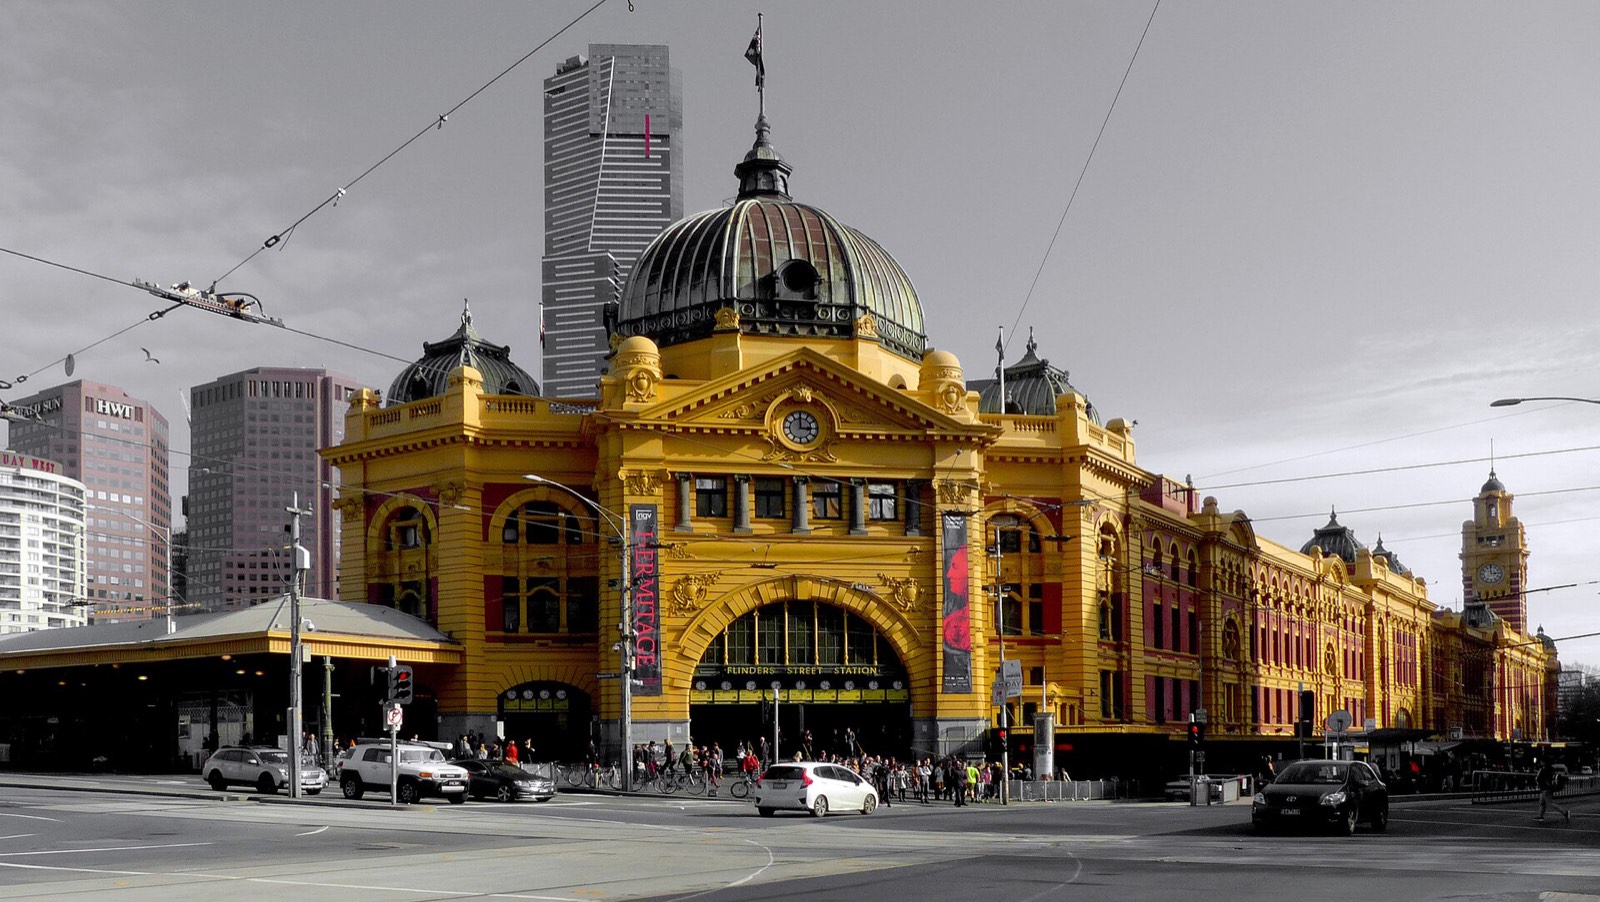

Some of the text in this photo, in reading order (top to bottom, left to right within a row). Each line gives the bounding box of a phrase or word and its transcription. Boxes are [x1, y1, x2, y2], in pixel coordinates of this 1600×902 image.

[43, 398, 61, 411] SUN
[97, 400, 133, 418] HWT
[3, 454, 54, 473] UAY WEST
[635, 531, 656, 666] HERMITAGE
